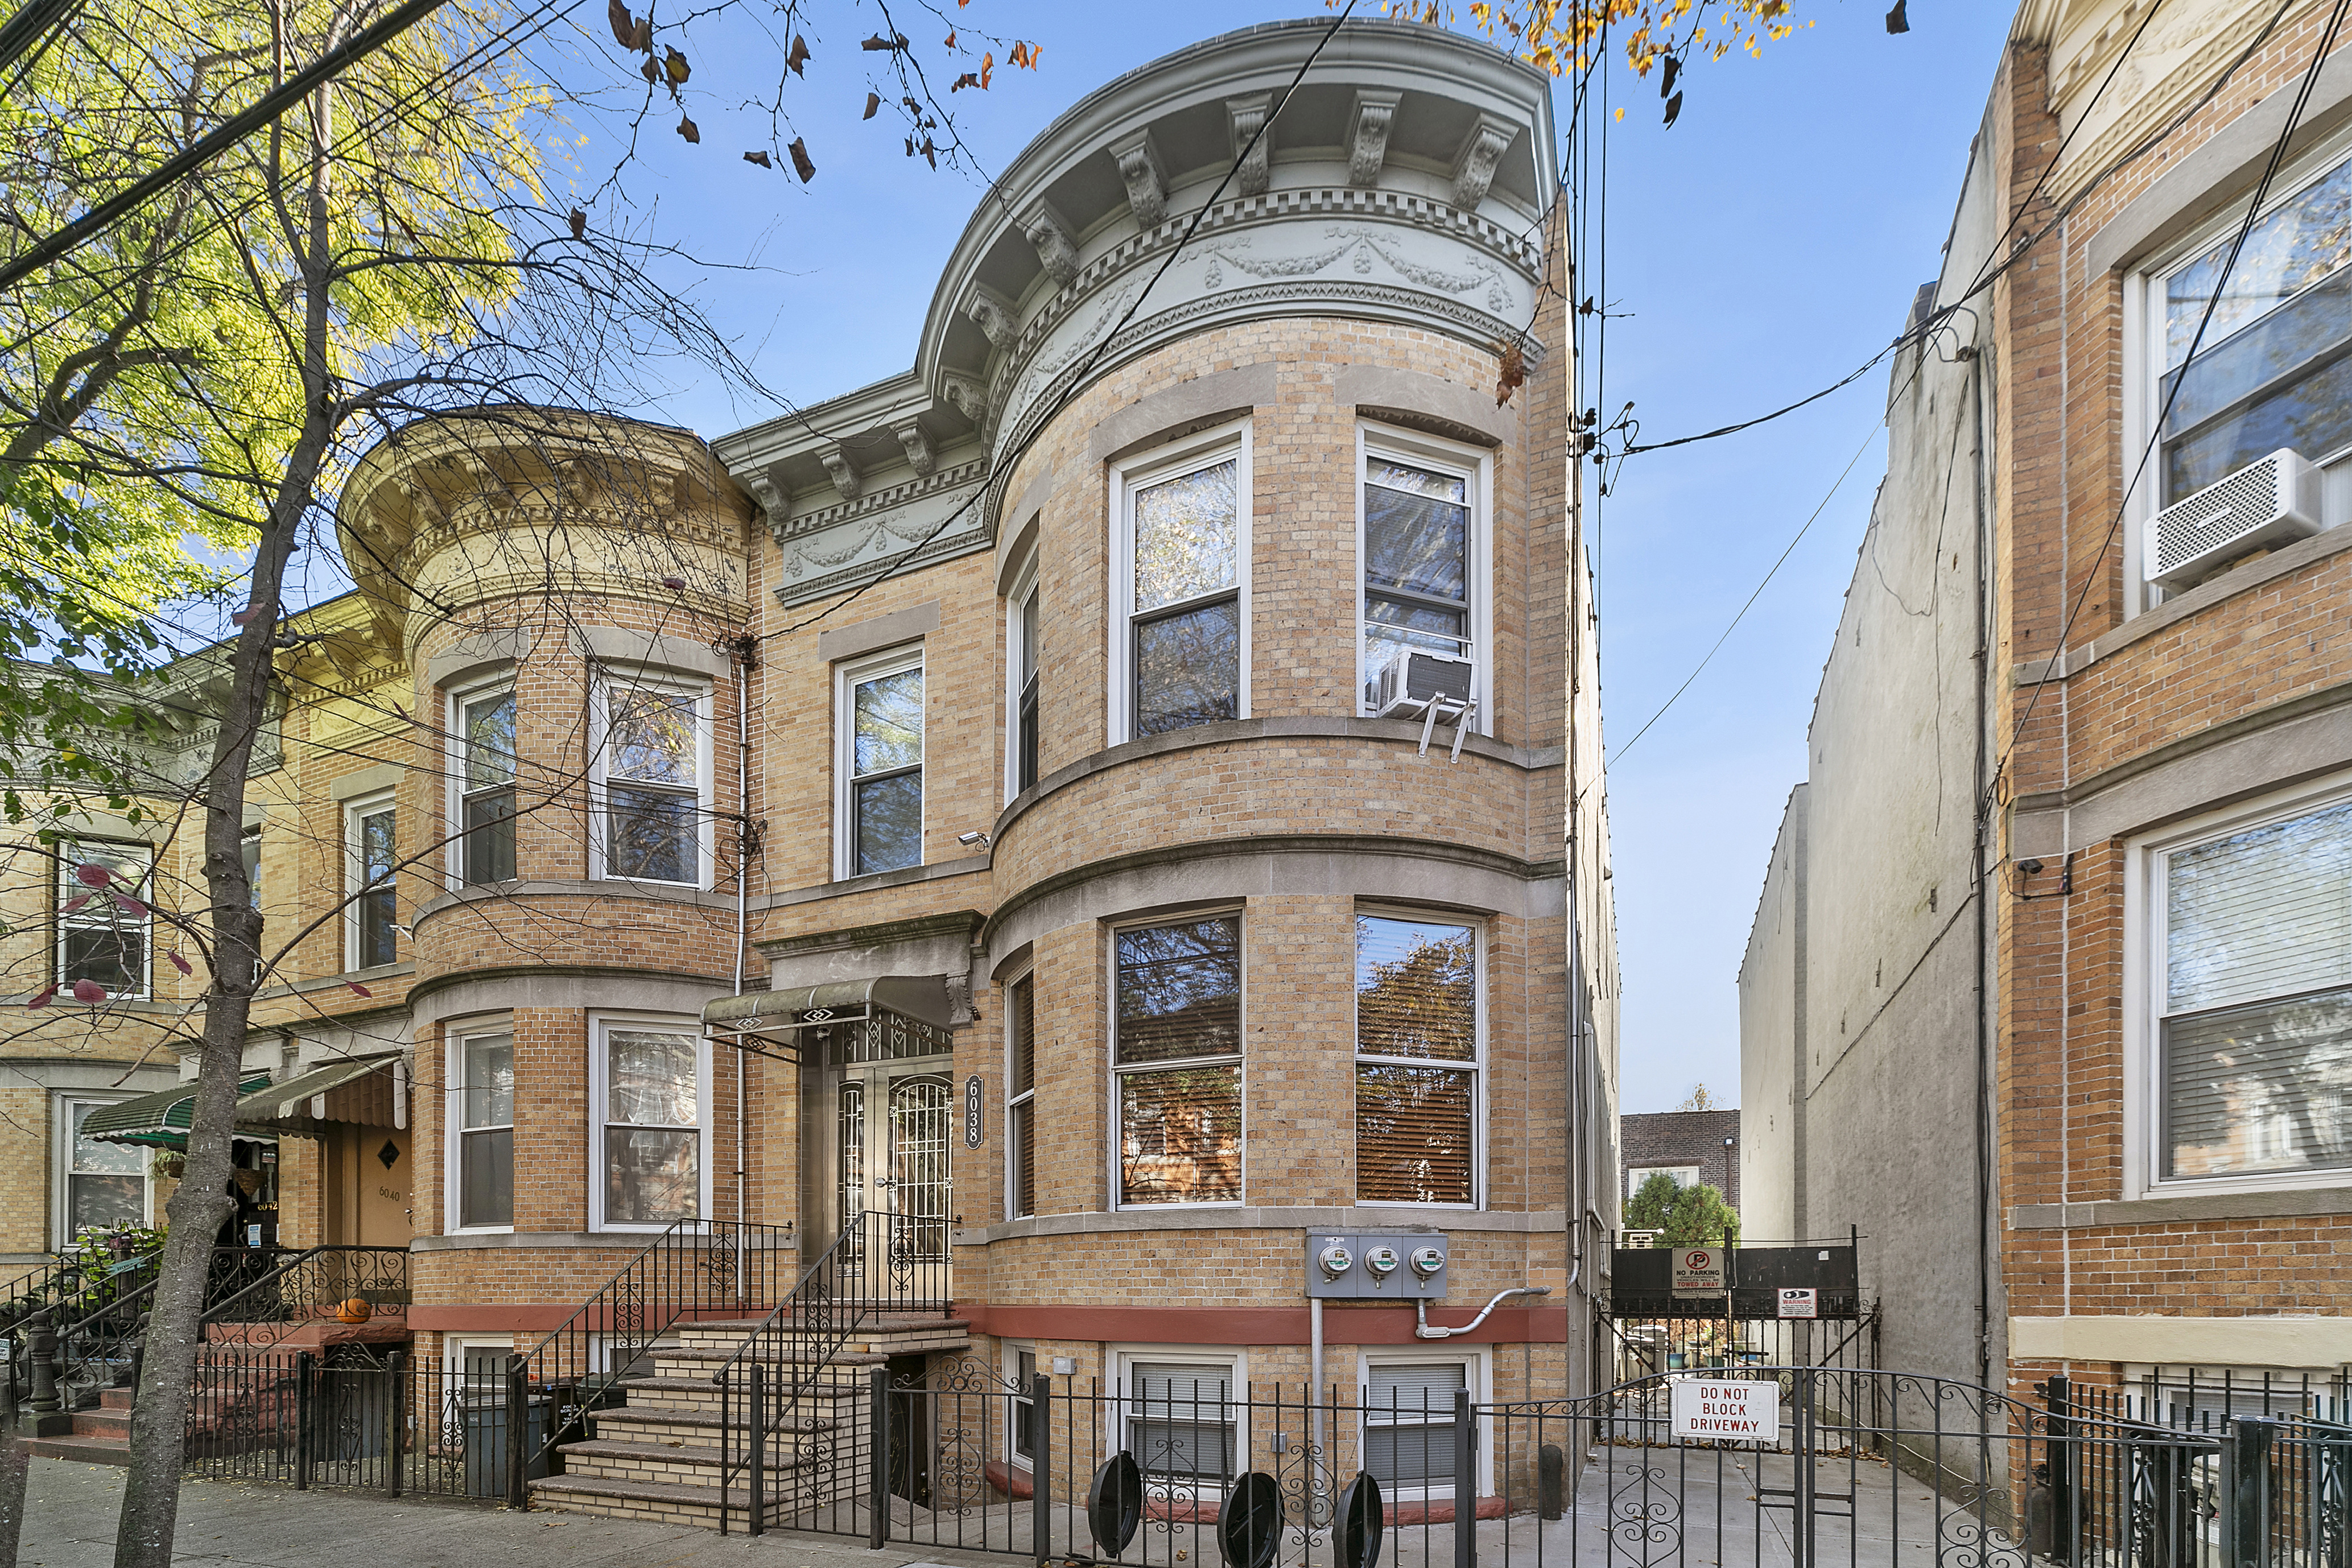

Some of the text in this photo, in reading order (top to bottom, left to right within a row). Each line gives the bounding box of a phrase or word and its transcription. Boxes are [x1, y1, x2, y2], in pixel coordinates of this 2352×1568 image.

[969, 1082, 978, 1142] 6038
[379, 1186, 399, 1201] 6040
[258, 1201, 278, 1211] 6042
[1701, 1387, 1749, 1400] DO NOT
[1703, 1403, 1746, 1416] BLOCK
[1691, 1418, 1759, 1432] DRIVEWAY
